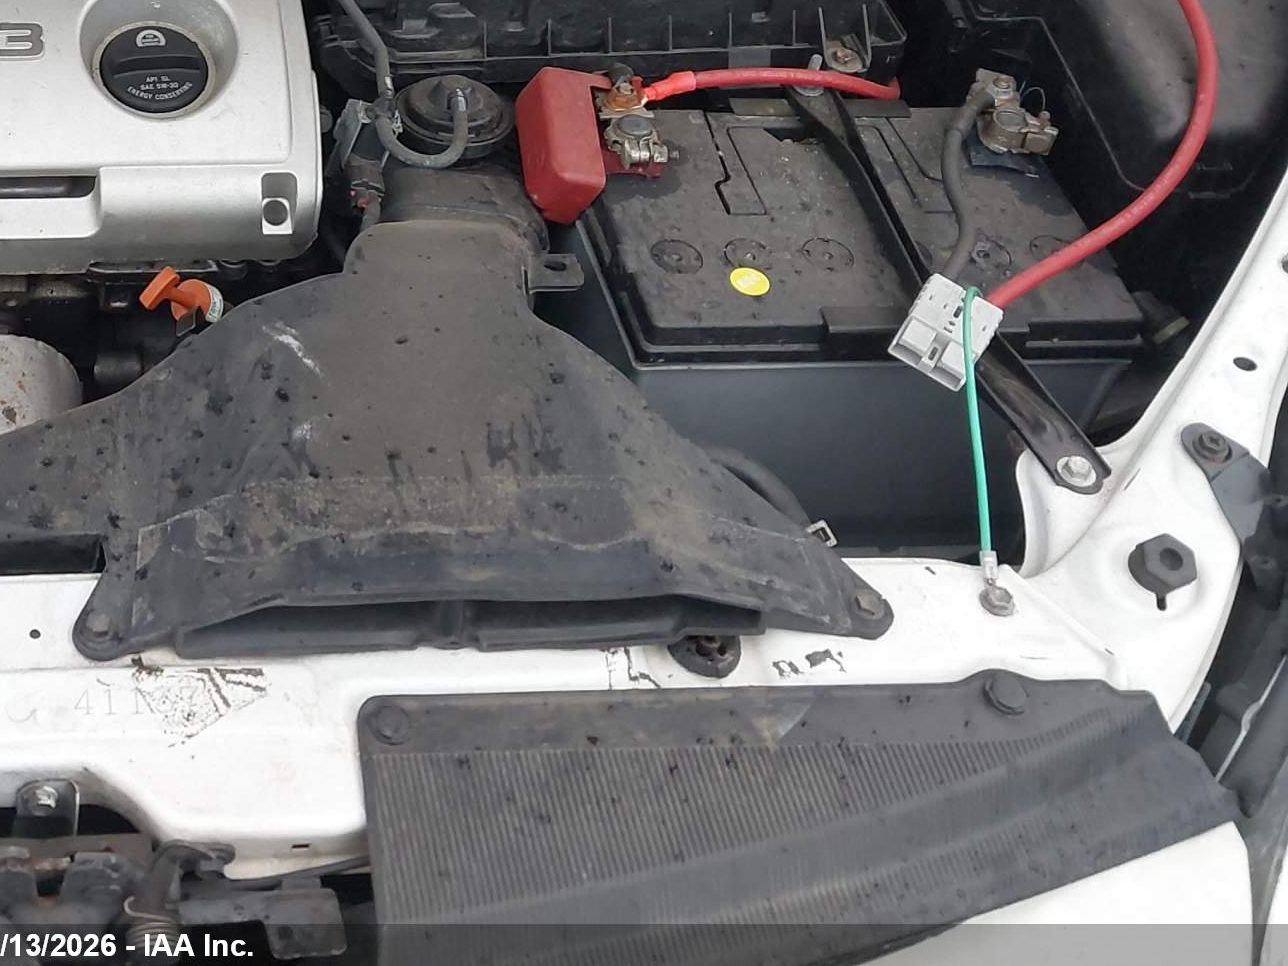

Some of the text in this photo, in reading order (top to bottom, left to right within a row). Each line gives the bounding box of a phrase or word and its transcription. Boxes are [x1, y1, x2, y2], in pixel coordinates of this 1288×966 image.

[127, 81, 193, 100] ENERGY CONSERVING
[140, 83, 155, 91] SAE
